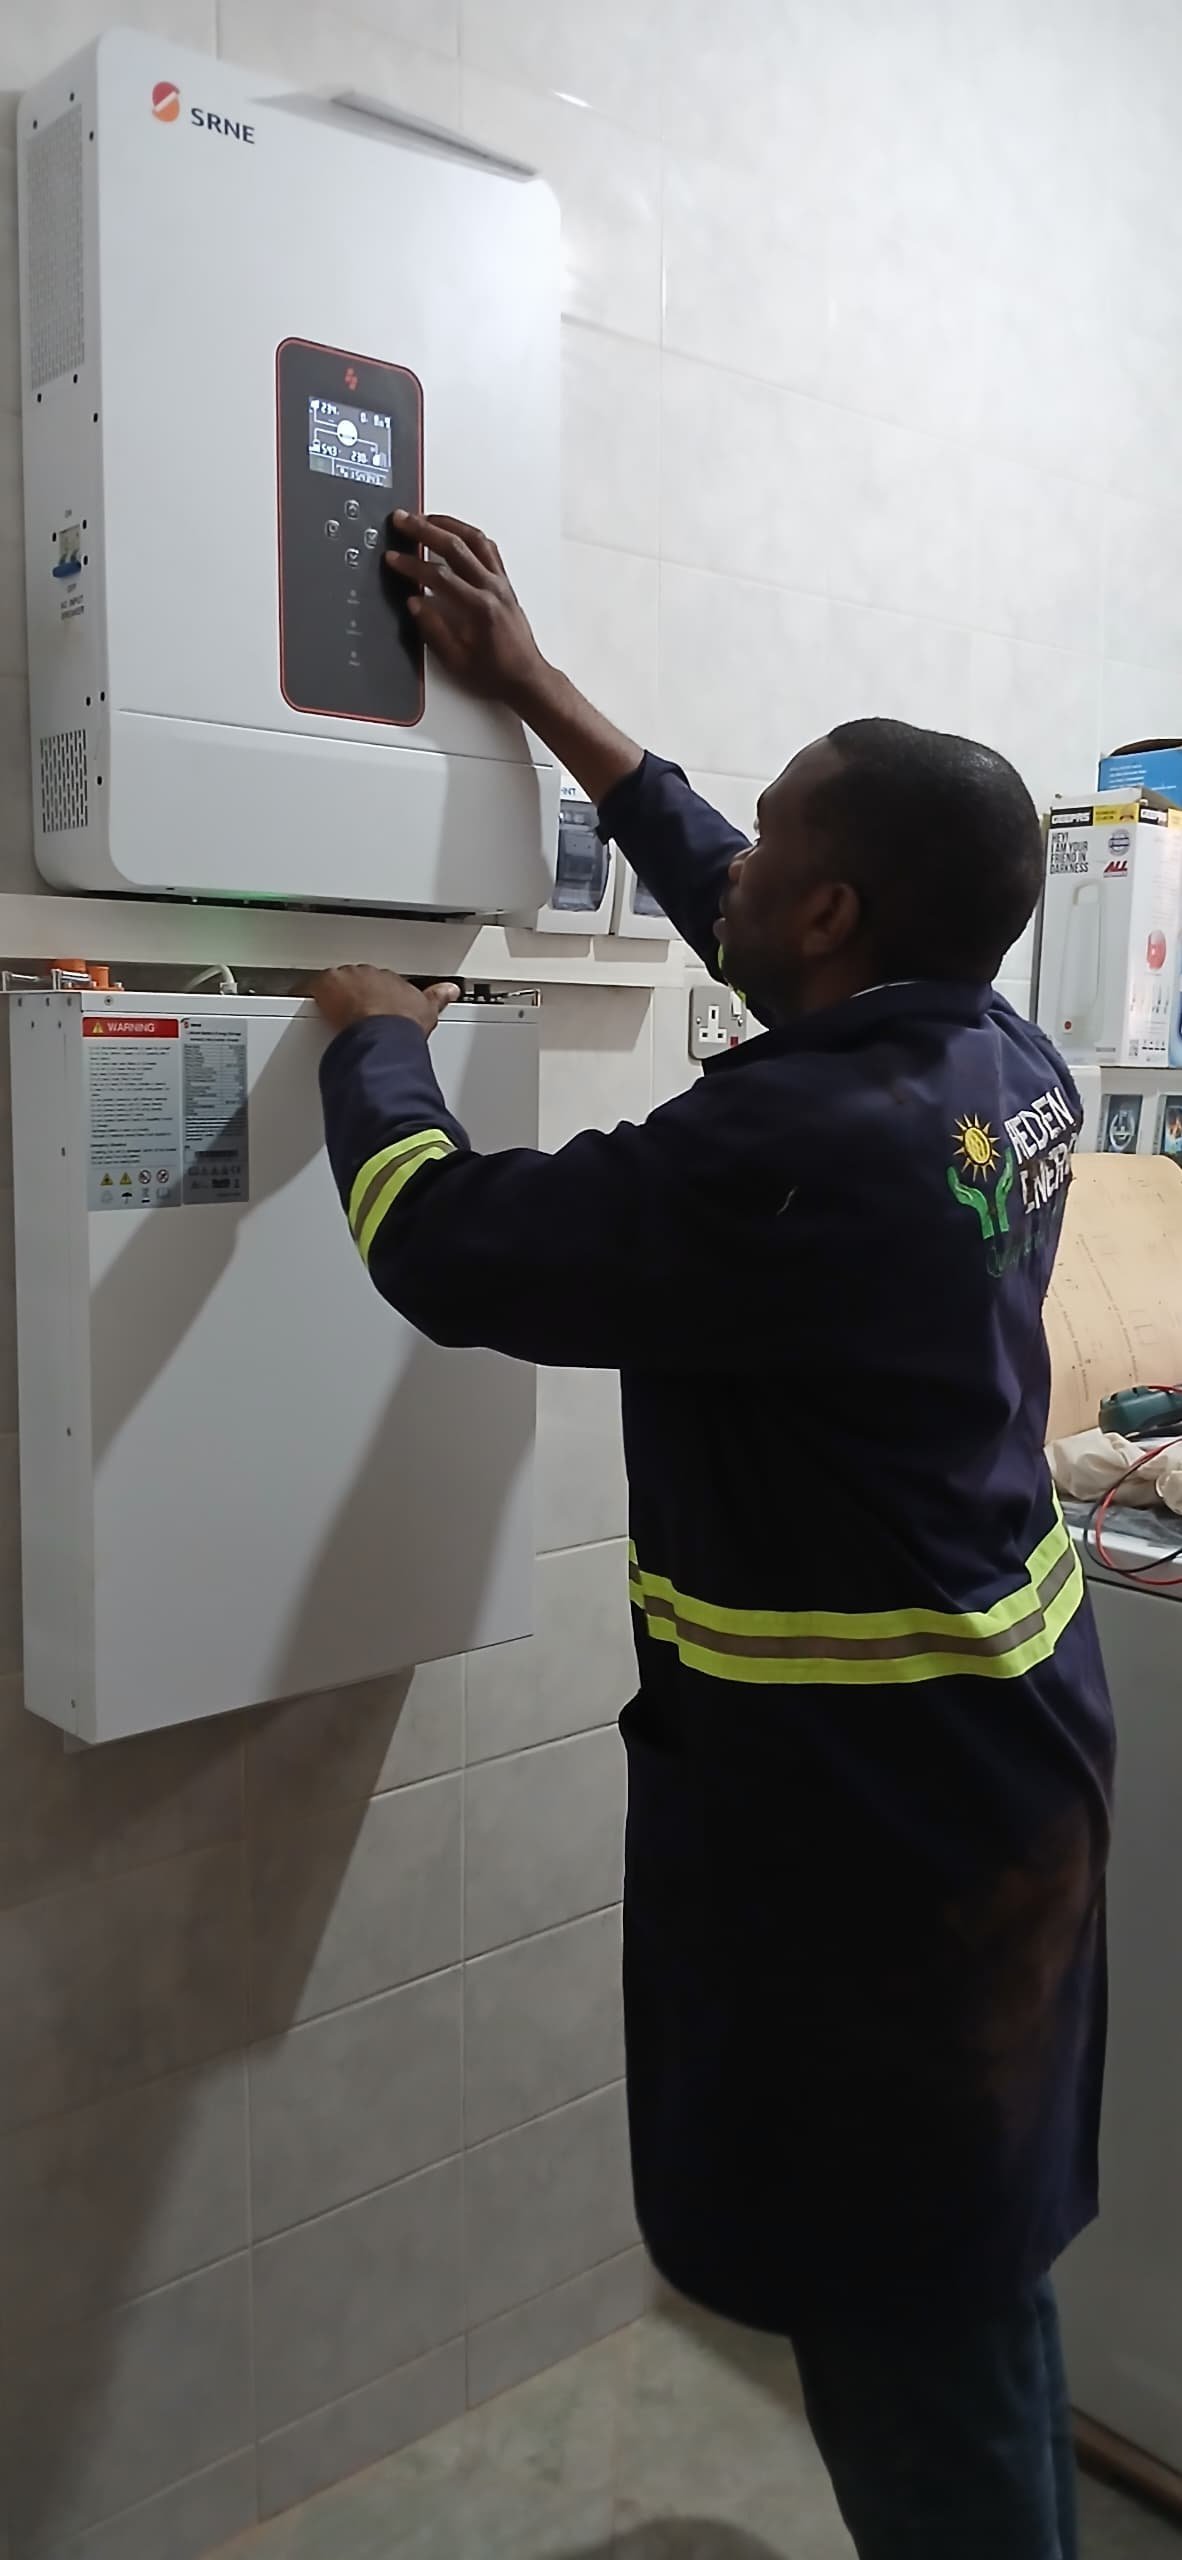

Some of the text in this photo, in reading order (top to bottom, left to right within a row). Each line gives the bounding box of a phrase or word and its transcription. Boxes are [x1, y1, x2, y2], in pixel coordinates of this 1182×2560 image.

[191, 107, 255, 144] SRNE
[1055, 842, 1067, 853] AM
[1068, 841, 1088, 852] YOUR
[1050, 852, 1086, 864] FRIEND IN
[1050, 862, 1089, 874] DARKNESS
[1103, 860, 1128, 873] ALL
[106, 1022, 156, 1033] WARNING
